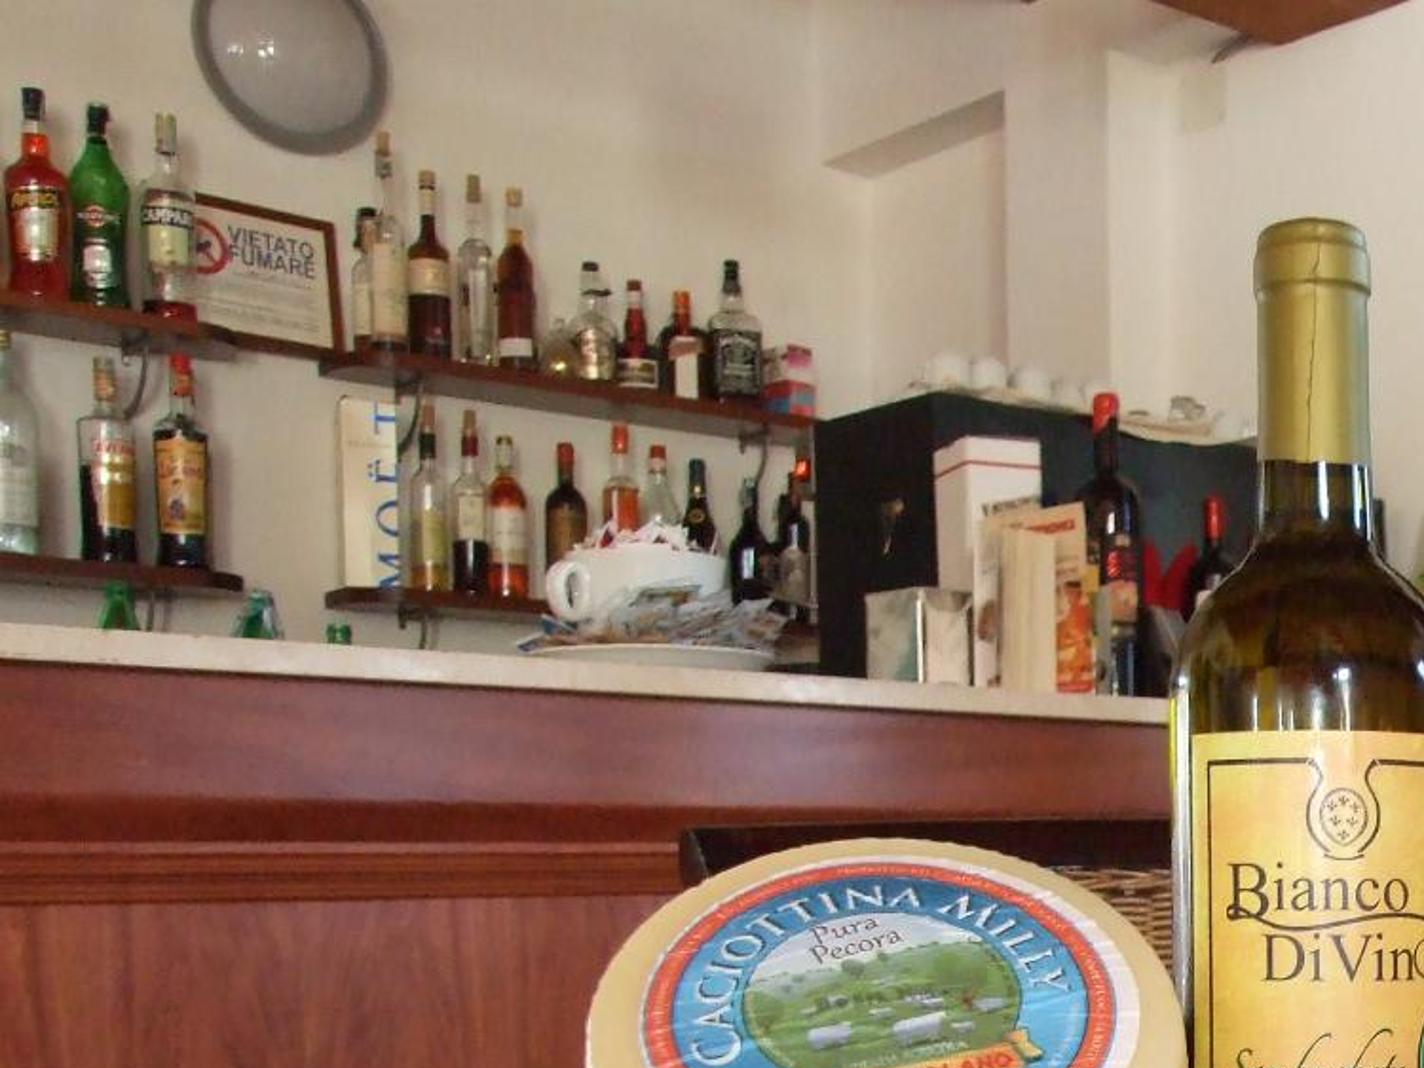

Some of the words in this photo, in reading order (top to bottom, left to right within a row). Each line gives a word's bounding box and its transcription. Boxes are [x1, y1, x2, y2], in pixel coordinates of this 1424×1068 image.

[227, 225, 314, 259] VIETATO
[229, 245, 316, 279] FUMARE
[1227, 862, 1409, 919] Bianco
[807, 930, 904, 965] Pecora
[809, 918, 879, 946] Pura
[691, 884, 920, 1067] CACIOTTINA
[937, 895, 1072, 992] MILLY
